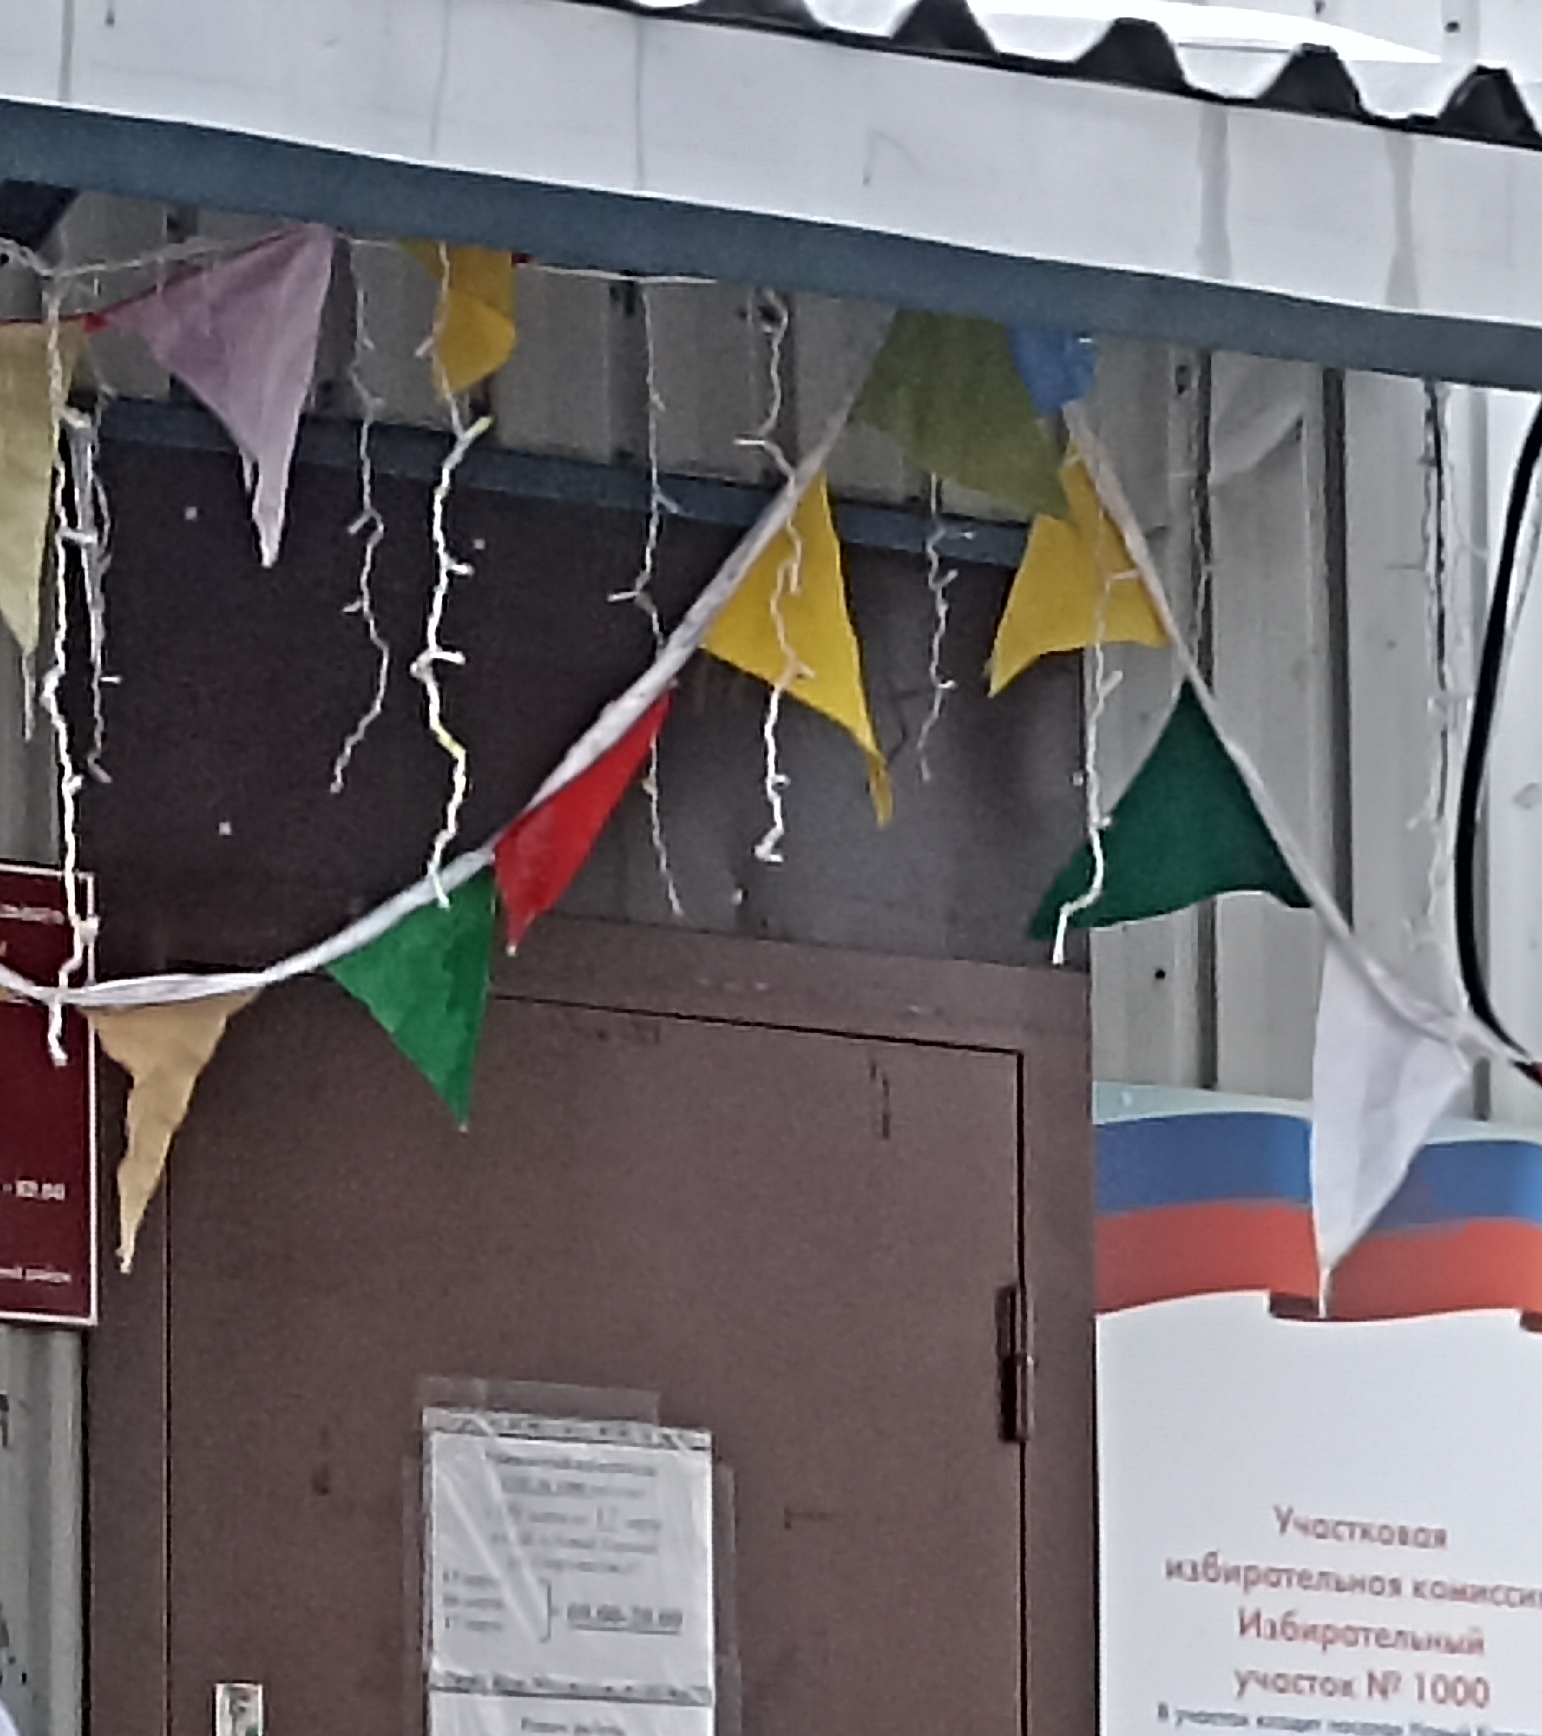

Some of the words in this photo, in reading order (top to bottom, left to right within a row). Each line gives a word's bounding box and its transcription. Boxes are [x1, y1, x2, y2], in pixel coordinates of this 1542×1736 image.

[1273, 1503, 1448, 1549] Участковая
[1164, 1551, 1403, 1595] избирательная
[1238, 1607, 1485, 1655] Избирательный
[1233, 1668, 1355, 1699] участок
[1414, 1672, 1491, 1709] 1000
